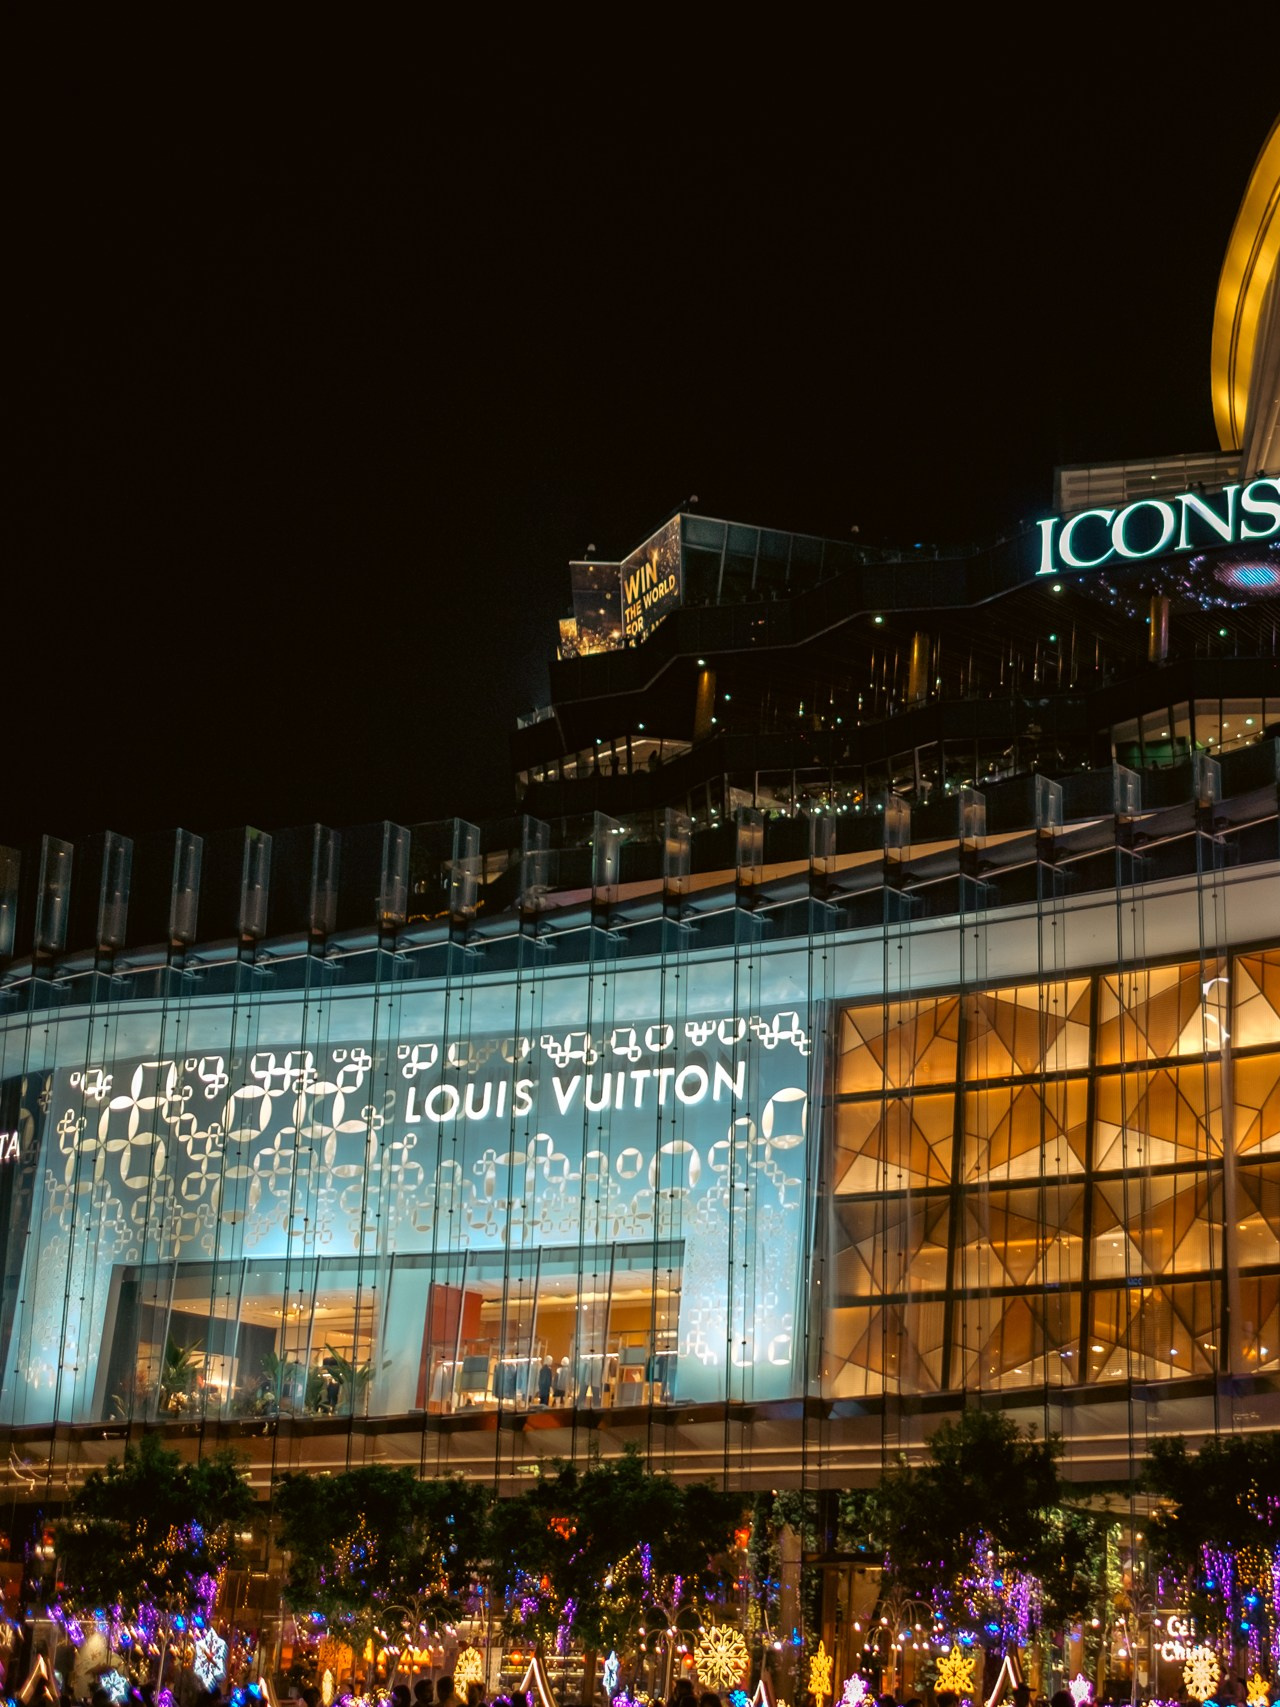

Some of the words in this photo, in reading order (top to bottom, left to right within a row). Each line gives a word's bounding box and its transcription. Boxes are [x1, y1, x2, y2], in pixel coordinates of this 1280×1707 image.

[624, 555, 658, 604] WIN
[625, 600, 642, 623] THE
[643, 574, 676, 609] WORLD
[626, 616, 644, 636] FOR
[405, 1078, 535, 1124] LOUIS
[552, 1060, 746, 1116] VUITTON
